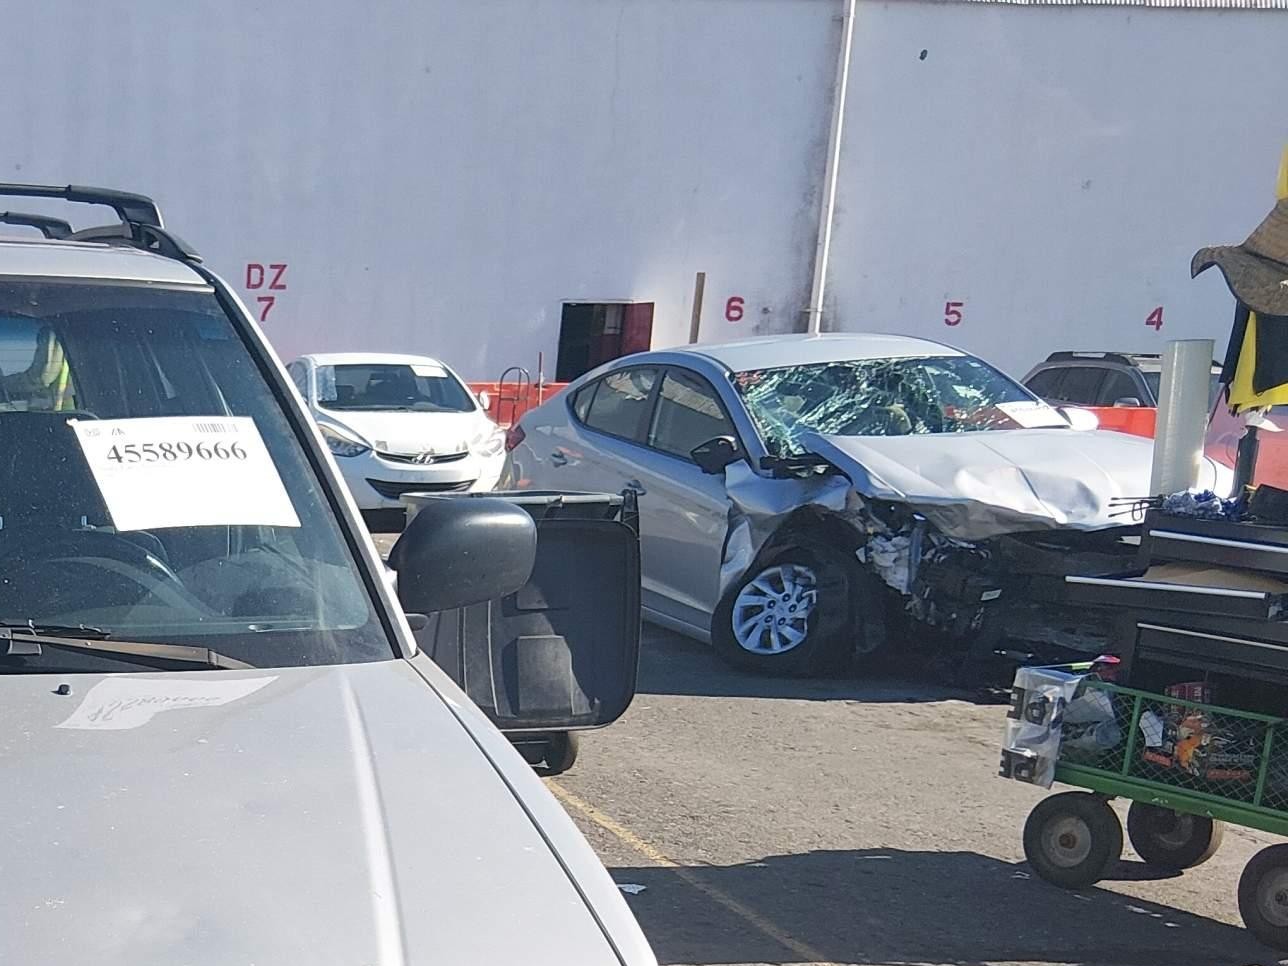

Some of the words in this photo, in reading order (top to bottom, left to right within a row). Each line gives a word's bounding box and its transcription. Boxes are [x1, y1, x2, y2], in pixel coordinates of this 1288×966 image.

[246, 263, 288, 290] DZ
[257, 296, 275, 322] 7
[725, 296, 745, 322] 6
[944, 301, 964, 327] 5
[1145, 306, 1163, 331] 4
[106, 440, 248, 463] 45589666
